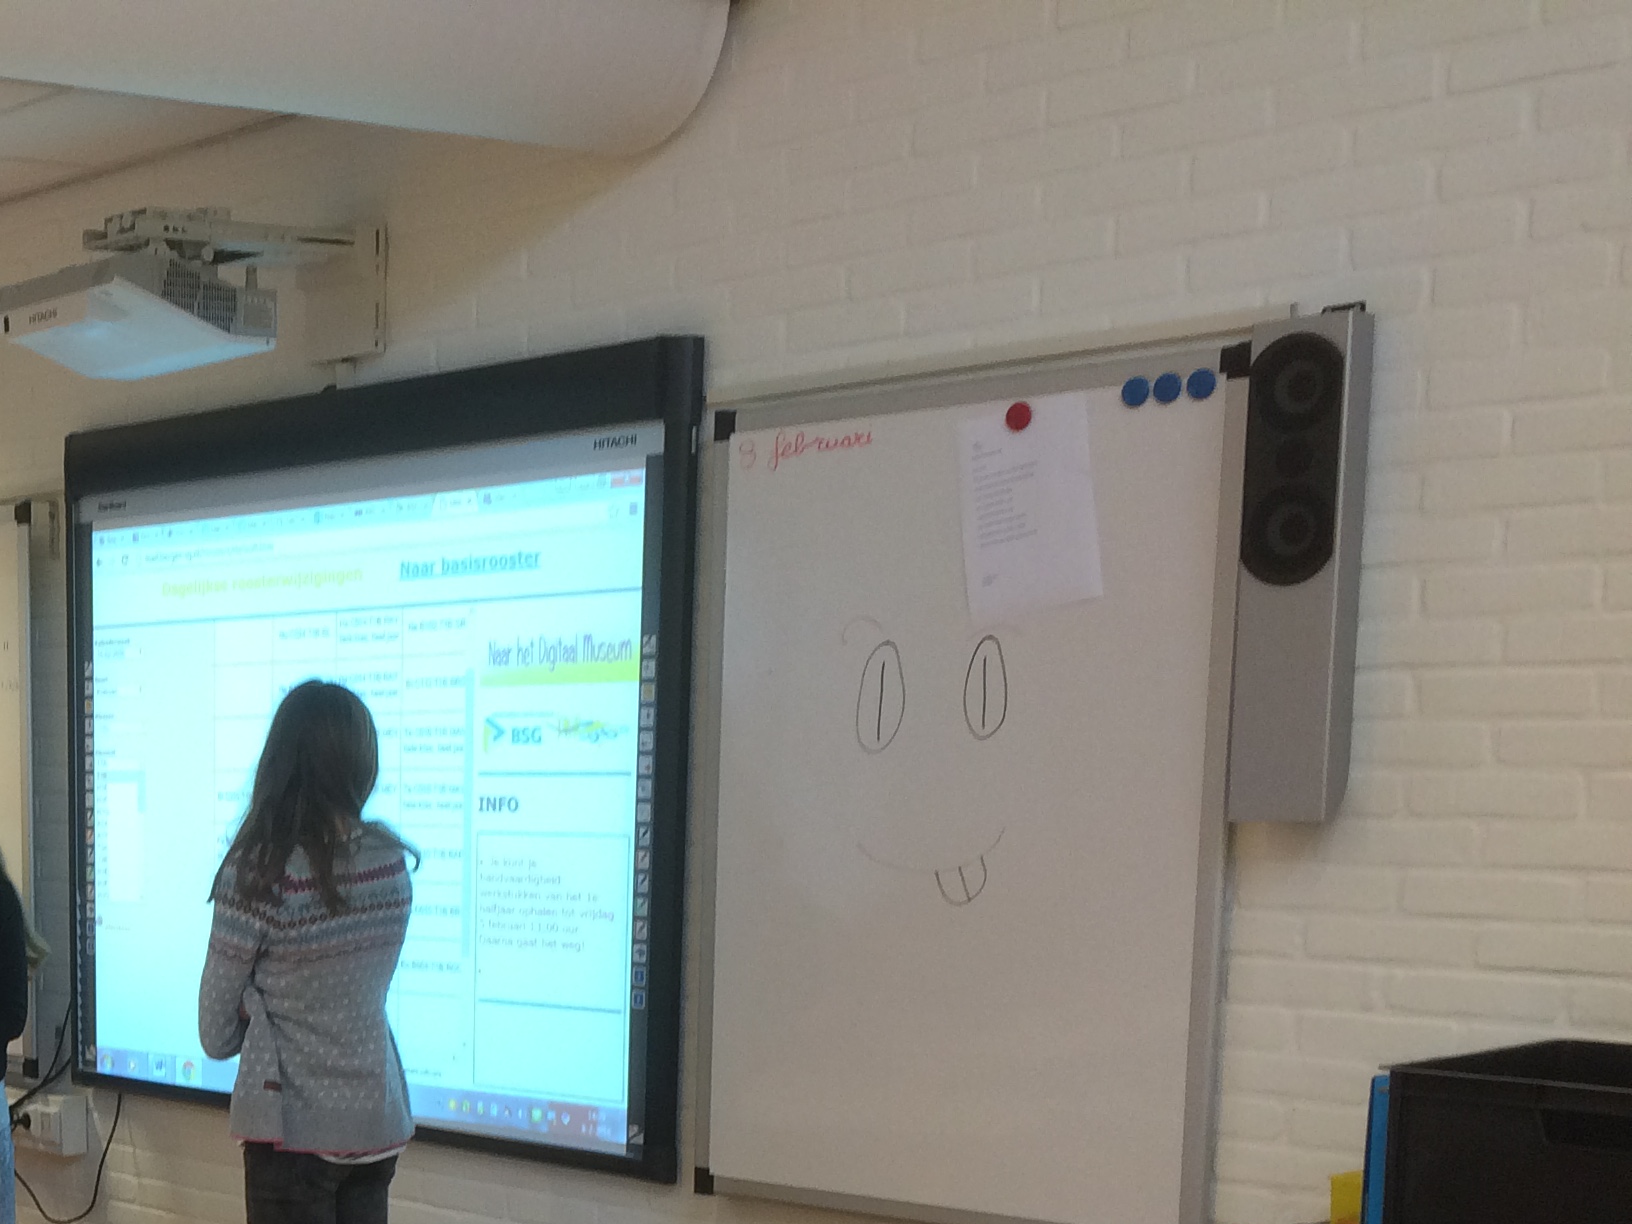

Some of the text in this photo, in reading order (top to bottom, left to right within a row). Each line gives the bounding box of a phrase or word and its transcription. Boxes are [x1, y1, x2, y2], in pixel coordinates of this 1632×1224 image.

[29, 307, 58, 325] HITACHI
[593, 433, 638, 451] HITACHI
[769, 427, 873, 473] februari
[399, 550, 542, 580] Naar basisrooster
[488, 632, 632, 673] Naar het Digitaal Museum
[510, 725, 543, 744] BSG
[478, 796, 519, 812] INFO
[579, 908, 615, 922] vrijdag
